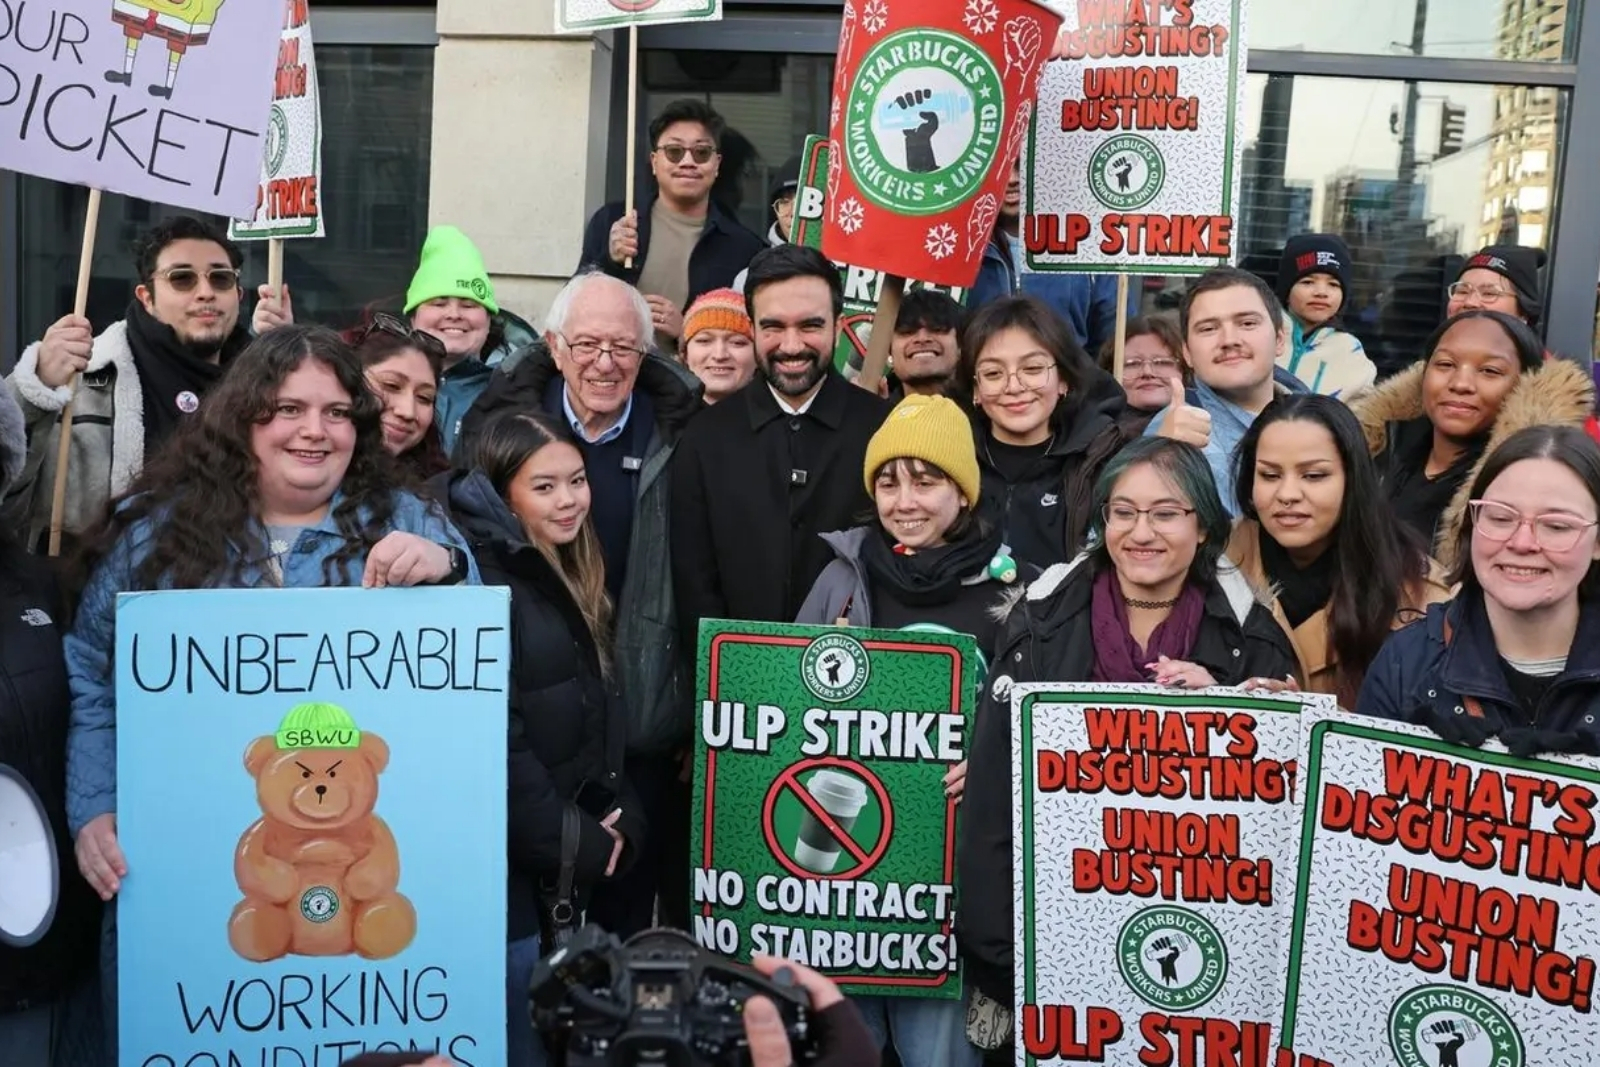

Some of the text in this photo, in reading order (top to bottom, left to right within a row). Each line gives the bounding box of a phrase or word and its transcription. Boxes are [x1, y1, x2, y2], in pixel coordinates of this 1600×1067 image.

[860, 40, 987, 96] STARBUCKS
[1049, 24, 1229, 61] ISGUSTING?
[1084, 66, 1178, 98] UNION
[1062, 96, 1199, 131] BUSTING!
[850, 104, 998, 201] WORKERS UNITED
[1100, 140, 1156, 160] STARBUCKS
[1094, 172, 1125, 205] WORKERS
[1025, 213, 1233, 257] ULP STRIKE
[132, 627, 503, 694] UNBEARABLE
[812, 638, 861, 657] STARBUCKS
[806, 665, 865, 697] WORKERS UNITED
[285, 729, 353, 747] SBWU
[701, 700, 965, 761] ULP STRIKE
[1084, 707, 1257, 757] WHAT'S
[1383, 747, 1598, 839] WHAT'S
[1102, 807, 1241, 859] UNION
[694, 867, 957, 929] NO CONTRACT,
[1072, 848, 1273, 907] BUSTING!
[1133, 913, 1212, 943] STARBUCKS
[1387, 863, 1560, 952] UNION
[694, 914, 958, 972] NO STARBUCKS!
[1347, 900, 1597, 1013] BUSTING!
[177, 966, 449, 1034] WORKING
[1126, 952, 1219, 1002] WORKERS UNITED
[1022, 1004, 1124, 1063] ULP
[1410, 993, 1507, 1037] STARBUCKS
